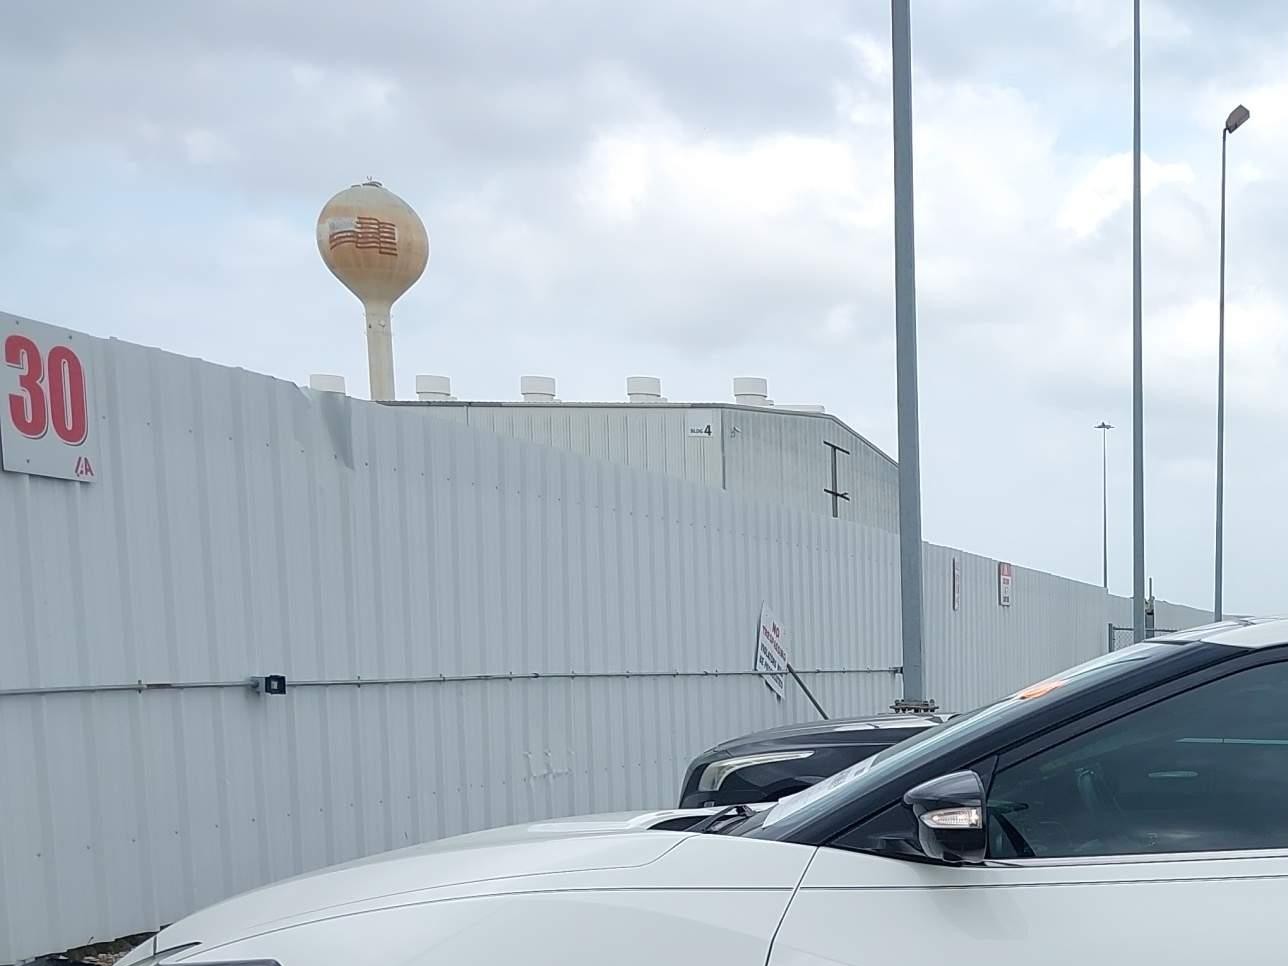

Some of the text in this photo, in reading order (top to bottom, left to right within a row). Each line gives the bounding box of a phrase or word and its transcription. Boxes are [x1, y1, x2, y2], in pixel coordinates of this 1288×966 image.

[5, 334, 88, 446] 30
[704, 424, 713, 436] 4
[772, 620, 781, 638] NO
